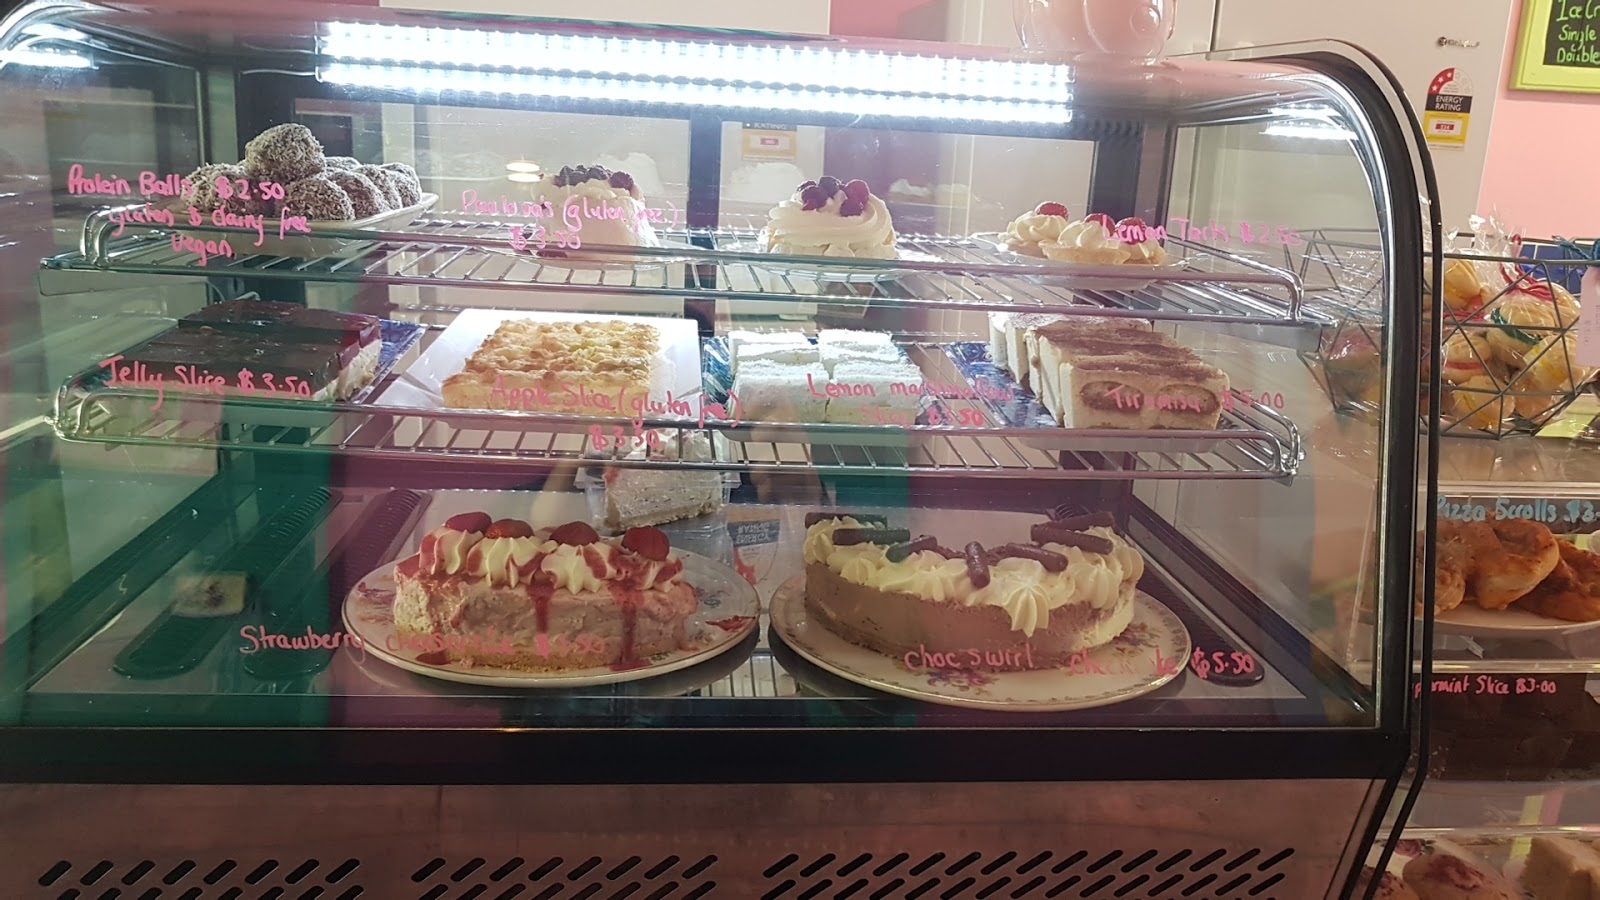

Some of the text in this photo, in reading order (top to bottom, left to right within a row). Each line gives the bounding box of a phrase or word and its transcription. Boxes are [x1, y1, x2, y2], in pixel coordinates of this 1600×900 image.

[1556, 0, 1582, 21] Ice
[1558, 24, 1597, 50] Single
[1557, 45, 1600, 64] Double
[1435, 95, 1463, 105] ENERGY
[1435, 103, 1462, 112] RATING
[754, 122, 787, 130] RATING
[68, 164, 285, 200] Protein Balls $2.50
[108, 202, 175, 237] gluten
[212, 205, 264, 247] dairy
[280, 206, 311, 240] free
[563, 194, 627, 232] (gluten
[1103, 215, 1168, 243] Lemon
[1170, 217, 1230, 243] Tarts
[171, 234, 233, 266] vegan
[99, 355, 310, 410] Jelly Slice $3.50
[807, 373, 876, 398] Lemon
[490, 375, 556, 410] Apple
[559, 381, 616, 413] Slice
[619, 386, 692, 429] (gluten
[1438, 495, 1486, 522] Pizza
[1495, 497, 1557, 523] Scrolls
[240, 625, 364, 663] Strawberry
[904, 643, 957, 671] choc
[970, 642, 1035, 669] swirl
[1191, 646, 1255, 680] $5.50
[1475, 675, 1510, 695] Slice
